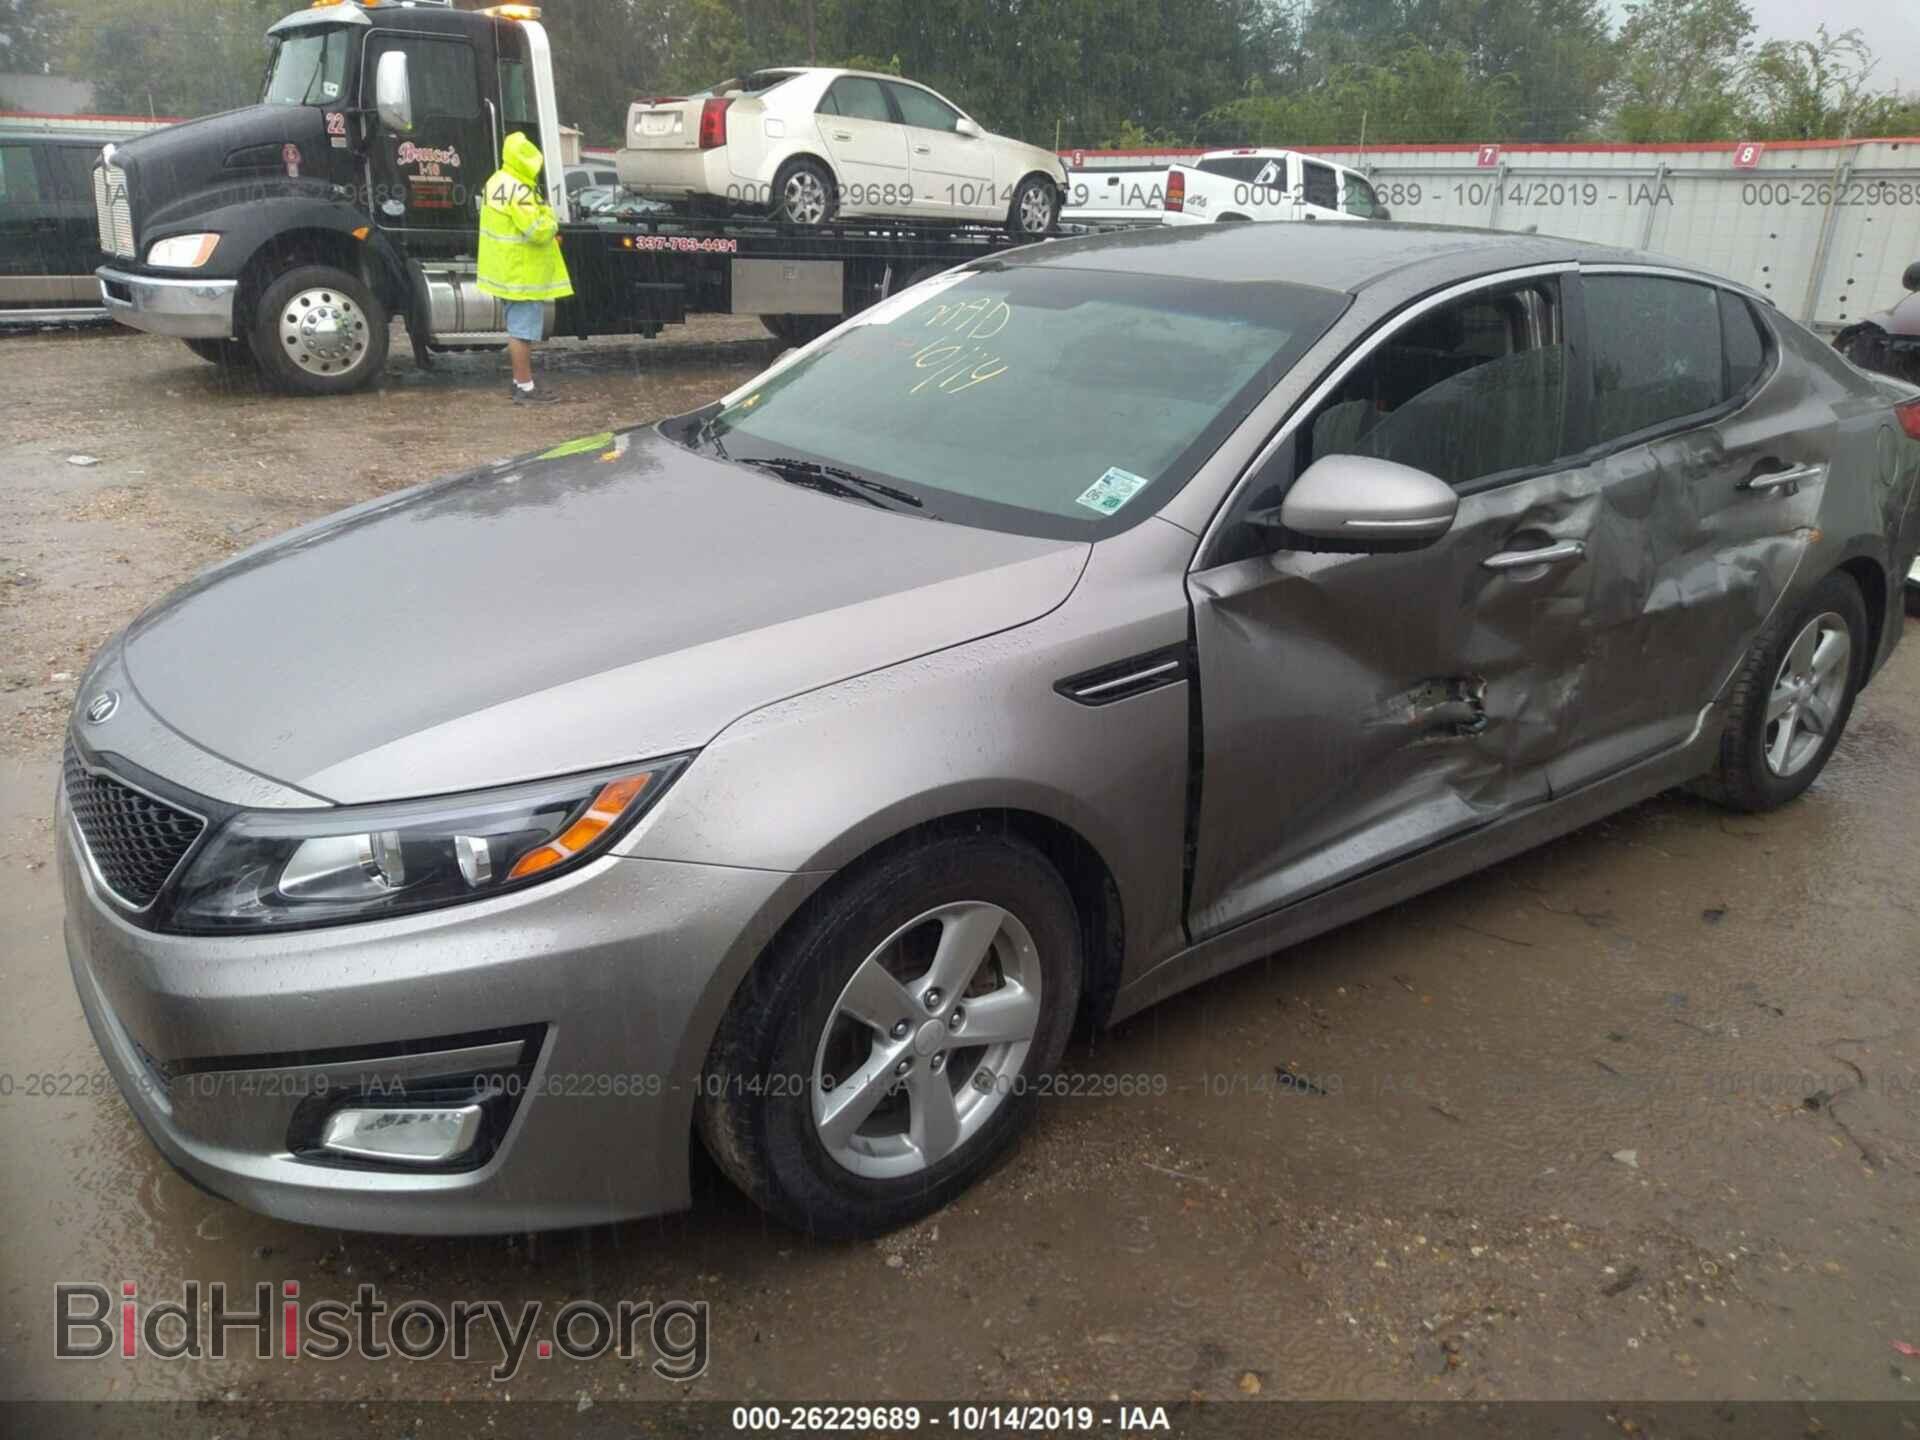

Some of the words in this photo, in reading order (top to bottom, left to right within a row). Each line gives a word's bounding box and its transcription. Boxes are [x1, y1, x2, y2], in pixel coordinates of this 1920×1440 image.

[325, 112, 347, 135] 22
[1484, 148, 1494, 163] 7
[1741, 147, 1754, 162] 8
[635, 236, 738, 253] 337-783-4491
